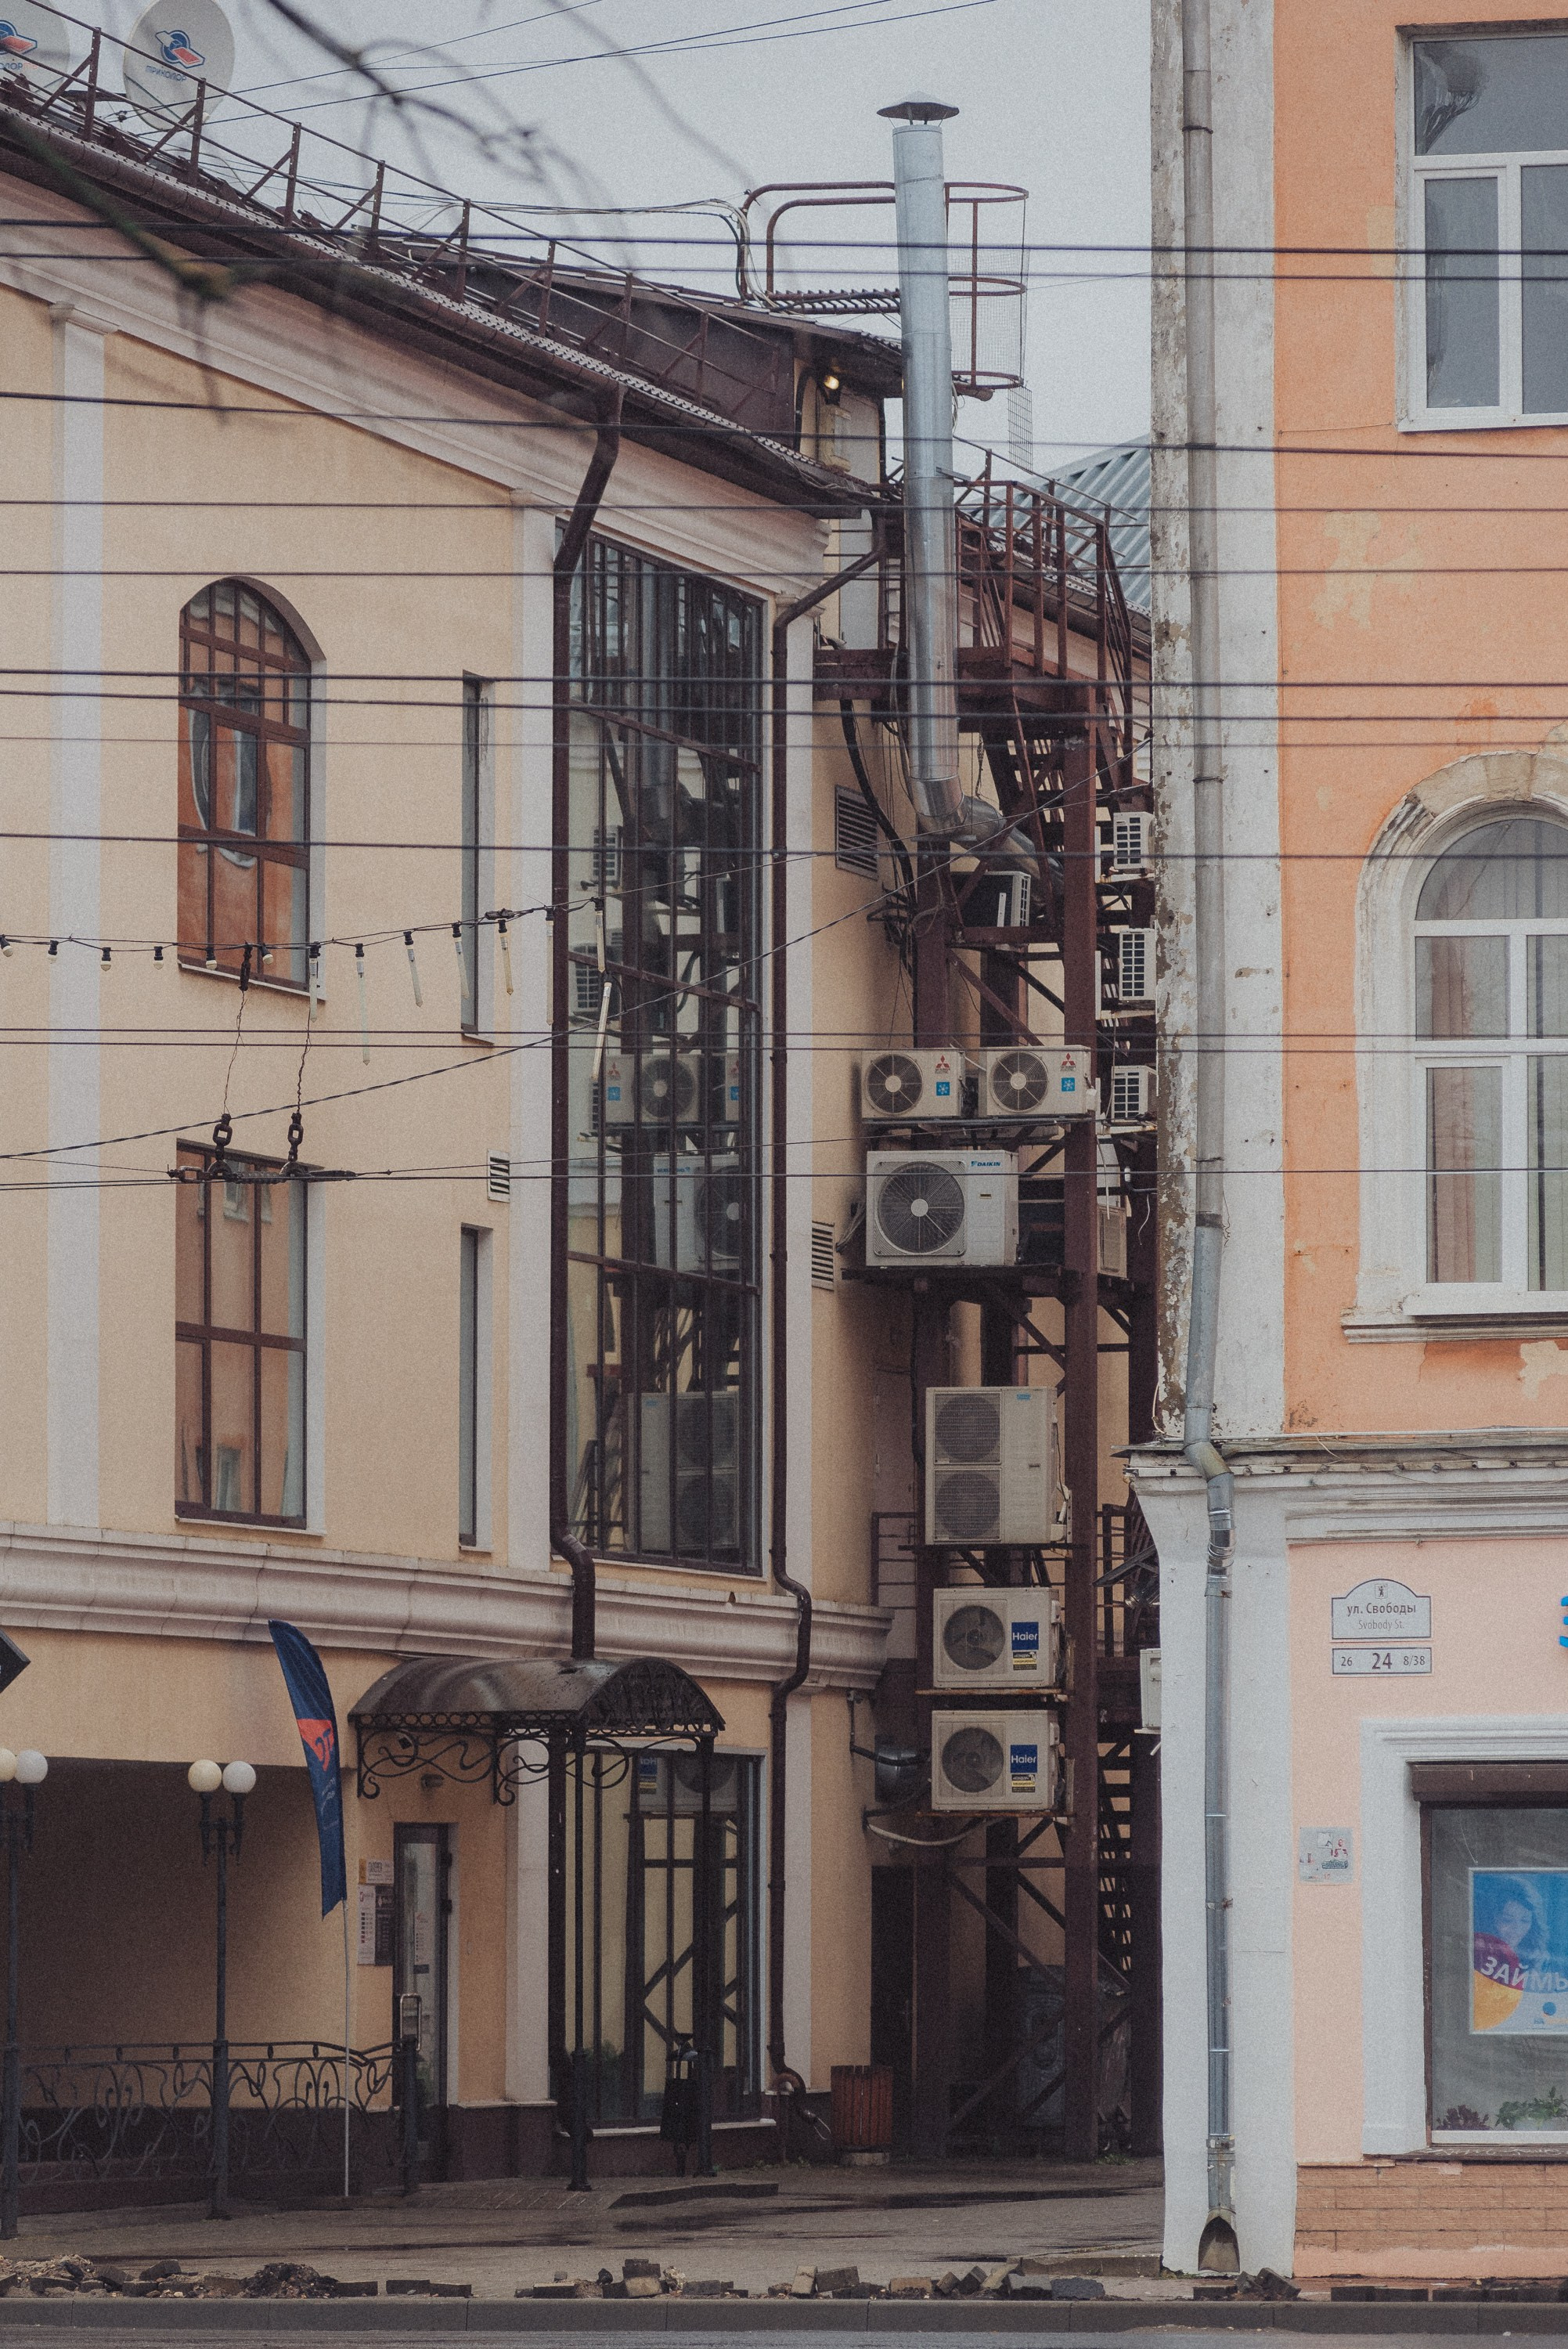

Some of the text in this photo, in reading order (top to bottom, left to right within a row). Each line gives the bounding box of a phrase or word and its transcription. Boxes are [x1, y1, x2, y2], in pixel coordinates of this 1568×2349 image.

[1346, 1602, 1416, 1617] ул. Свободы
[1358, 1619, 1405, 1631] Svobody St.
[1012, 1631, 1037, 1640] Haier
[1341, 1653, 1426, 1669] 26 24 8/38
[1011, 1754, 1036, 1763] Haier
